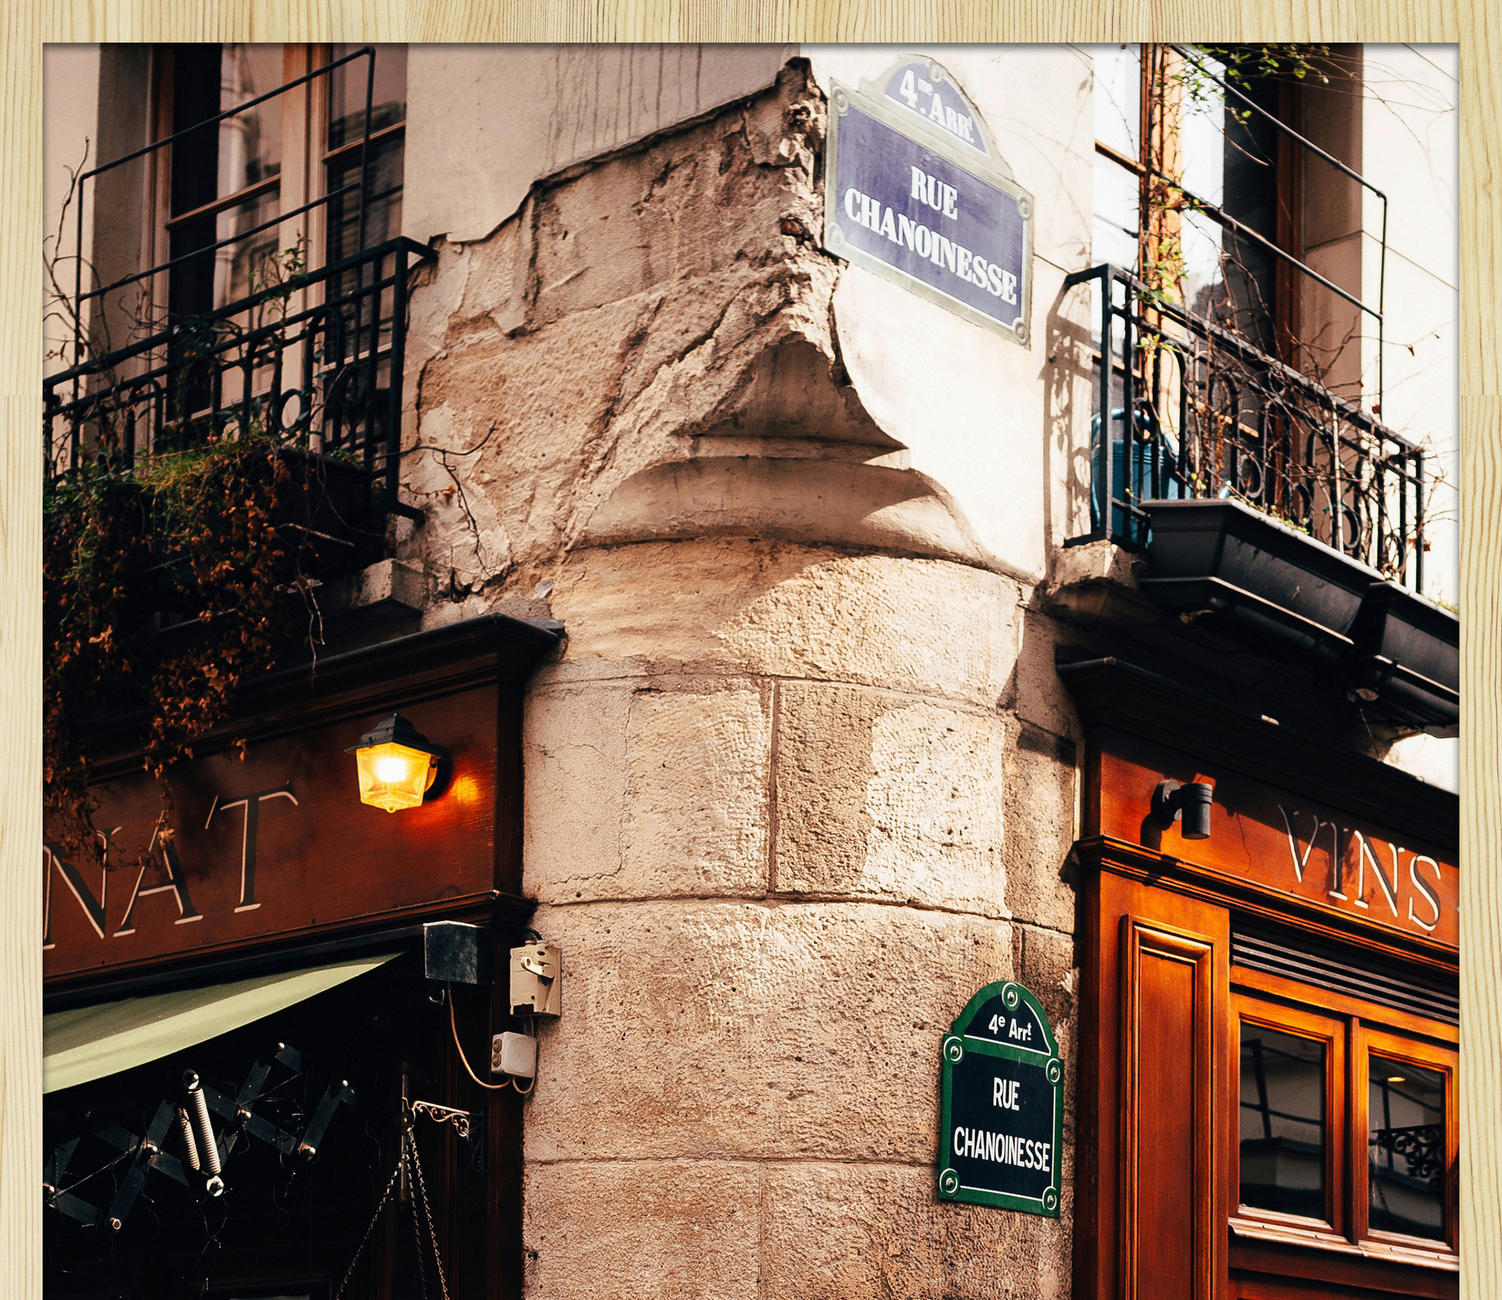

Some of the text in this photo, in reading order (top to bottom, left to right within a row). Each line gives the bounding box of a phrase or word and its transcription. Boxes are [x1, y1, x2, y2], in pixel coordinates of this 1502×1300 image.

[910, 166, 958, 220] RUE
[844, 187, 1017, 305] CHANOINESSE
[1278, 803, 1442, 931] VINS
[988, 1014, 1006, 1036] 4e
[993, 1076, 1021, 1112] RUE
[953, 1126, 1051, 1173] CHANOINESSE
